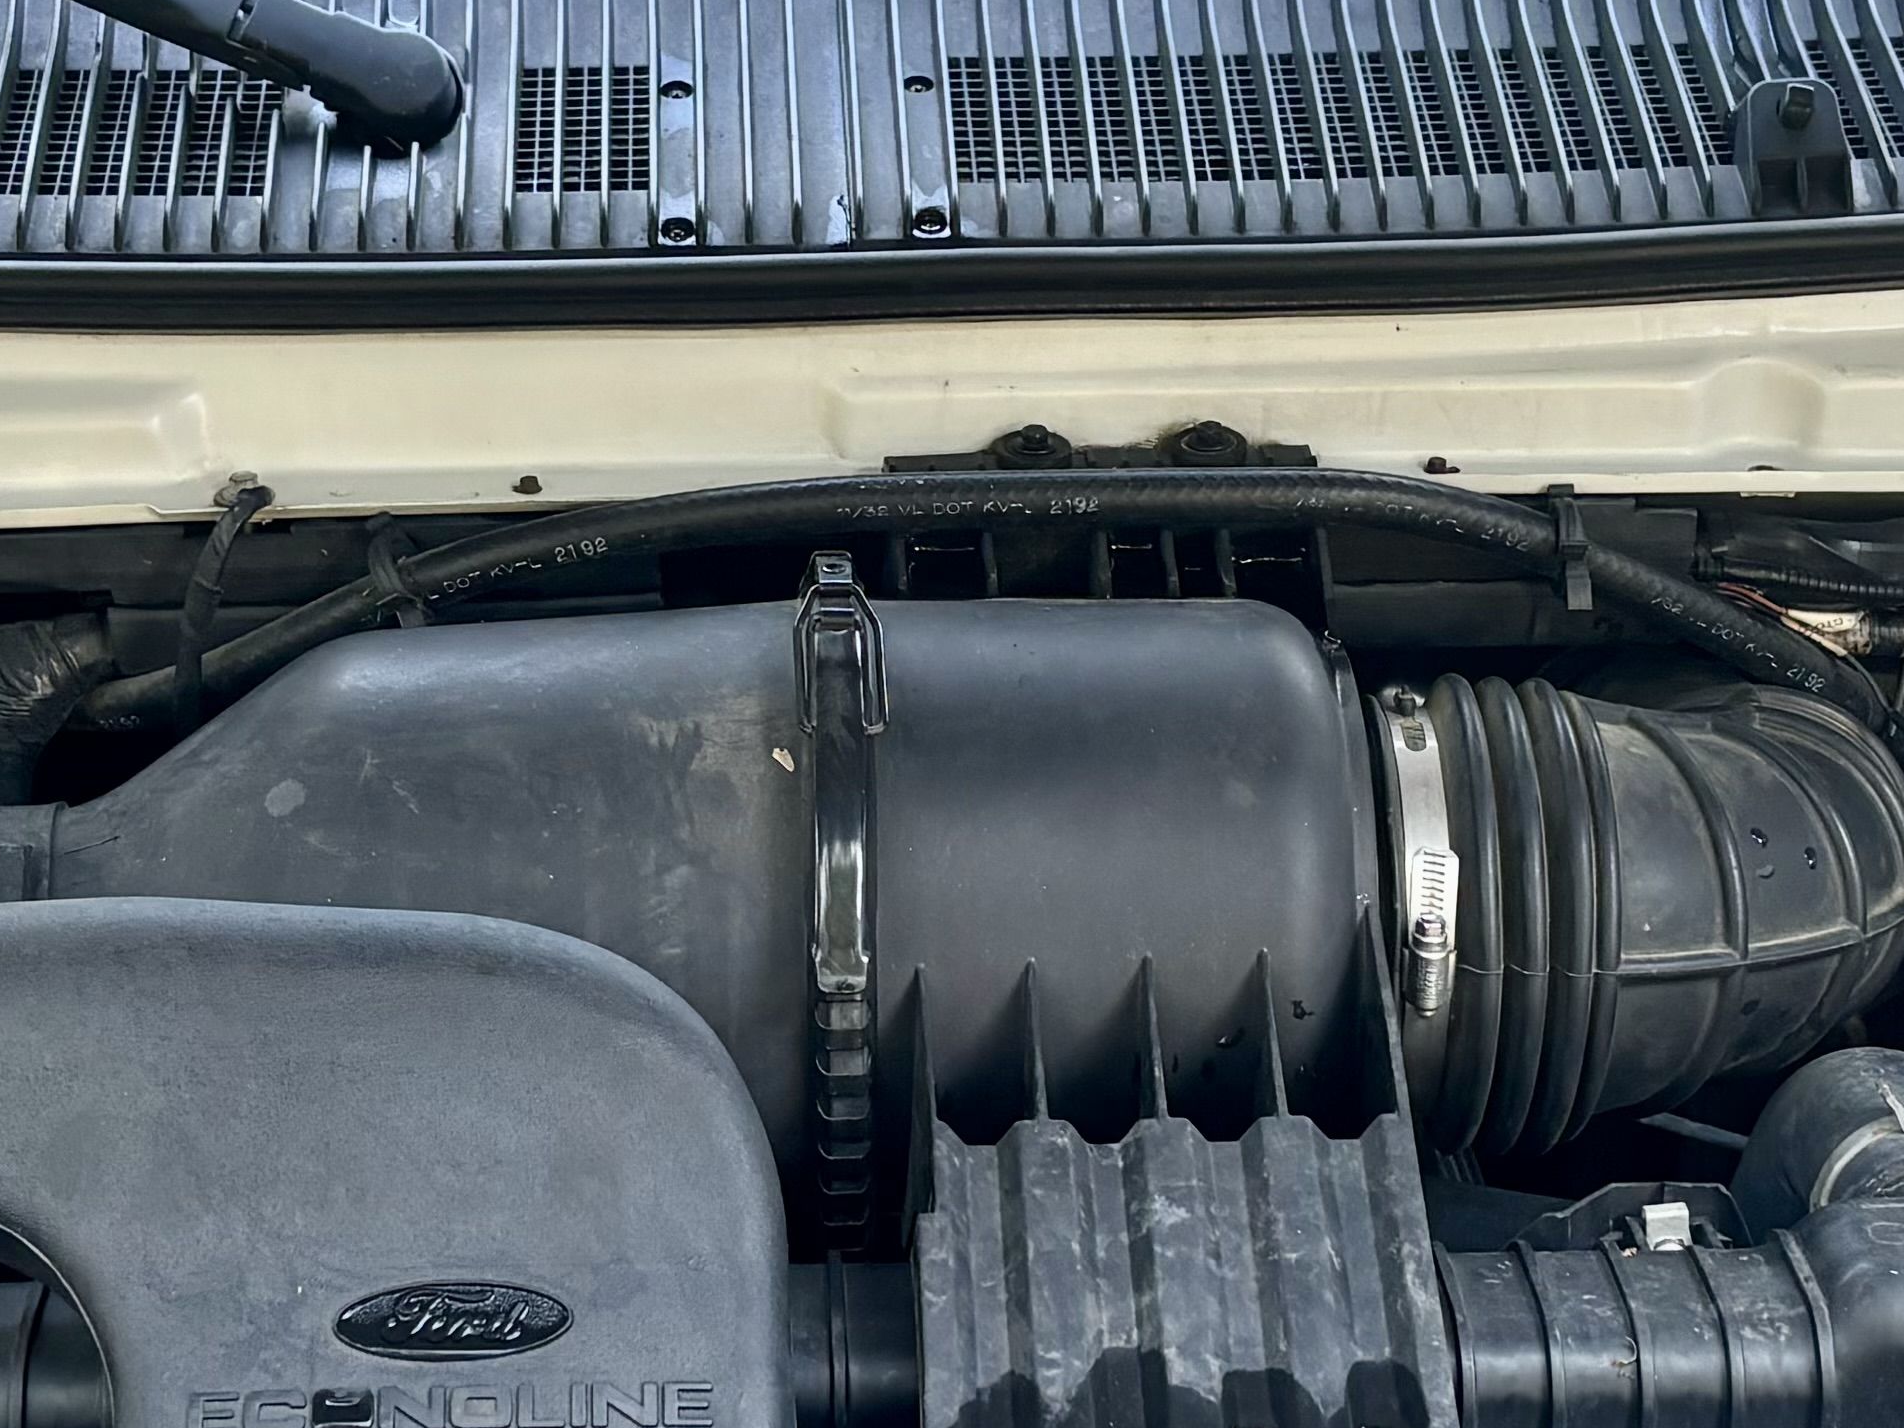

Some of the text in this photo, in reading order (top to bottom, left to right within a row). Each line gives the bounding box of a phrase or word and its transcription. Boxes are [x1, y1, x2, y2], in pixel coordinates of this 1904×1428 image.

[933, 502, 973, 514] DOT
[443, 571, 480, 593] DOT
[554, 537, 608, 564] 2192
